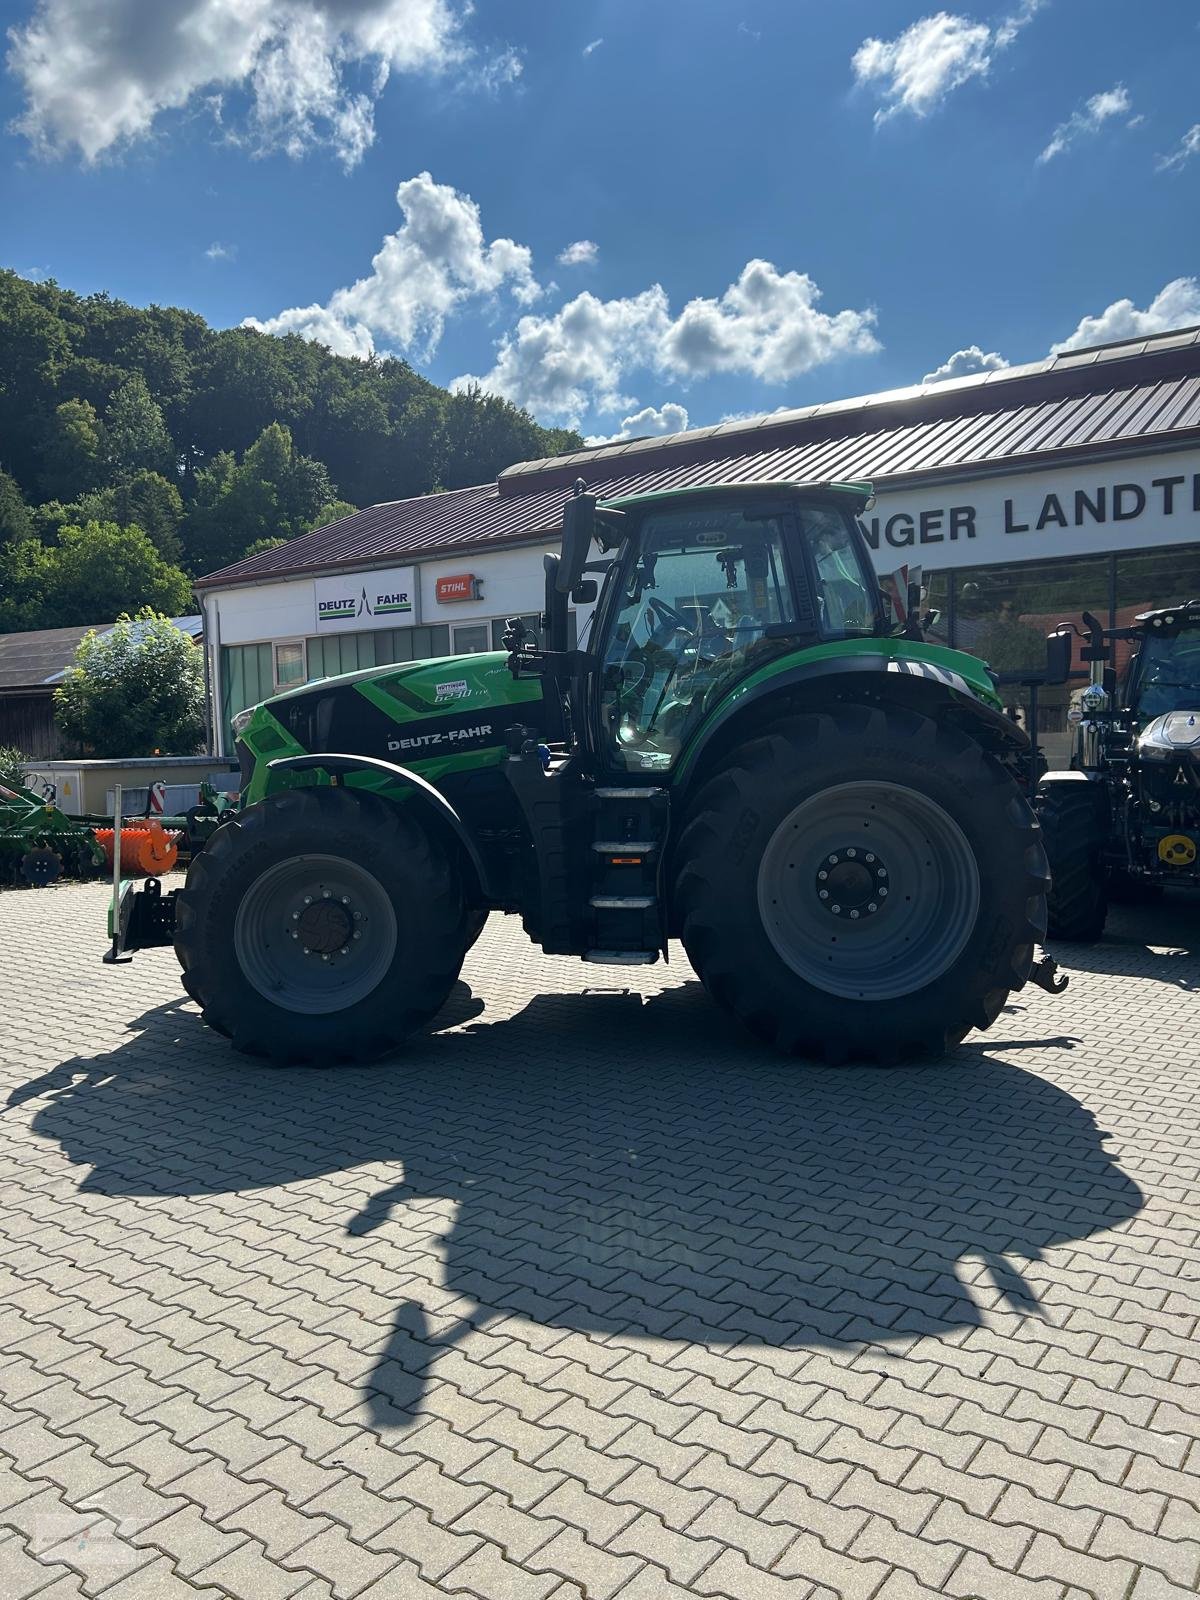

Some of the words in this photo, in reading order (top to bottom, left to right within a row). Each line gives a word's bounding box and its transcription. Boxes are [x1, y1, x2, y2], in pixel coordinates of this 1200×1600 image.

[440, 582, 466, 593] STIHL
[318, 598, 355, 611] DEUTZ
[377, 593, 407, 604] FAHR
[434, 689, 472, 703] 6230
[387, 725, 493, 752] DEUTZ-FAHR
